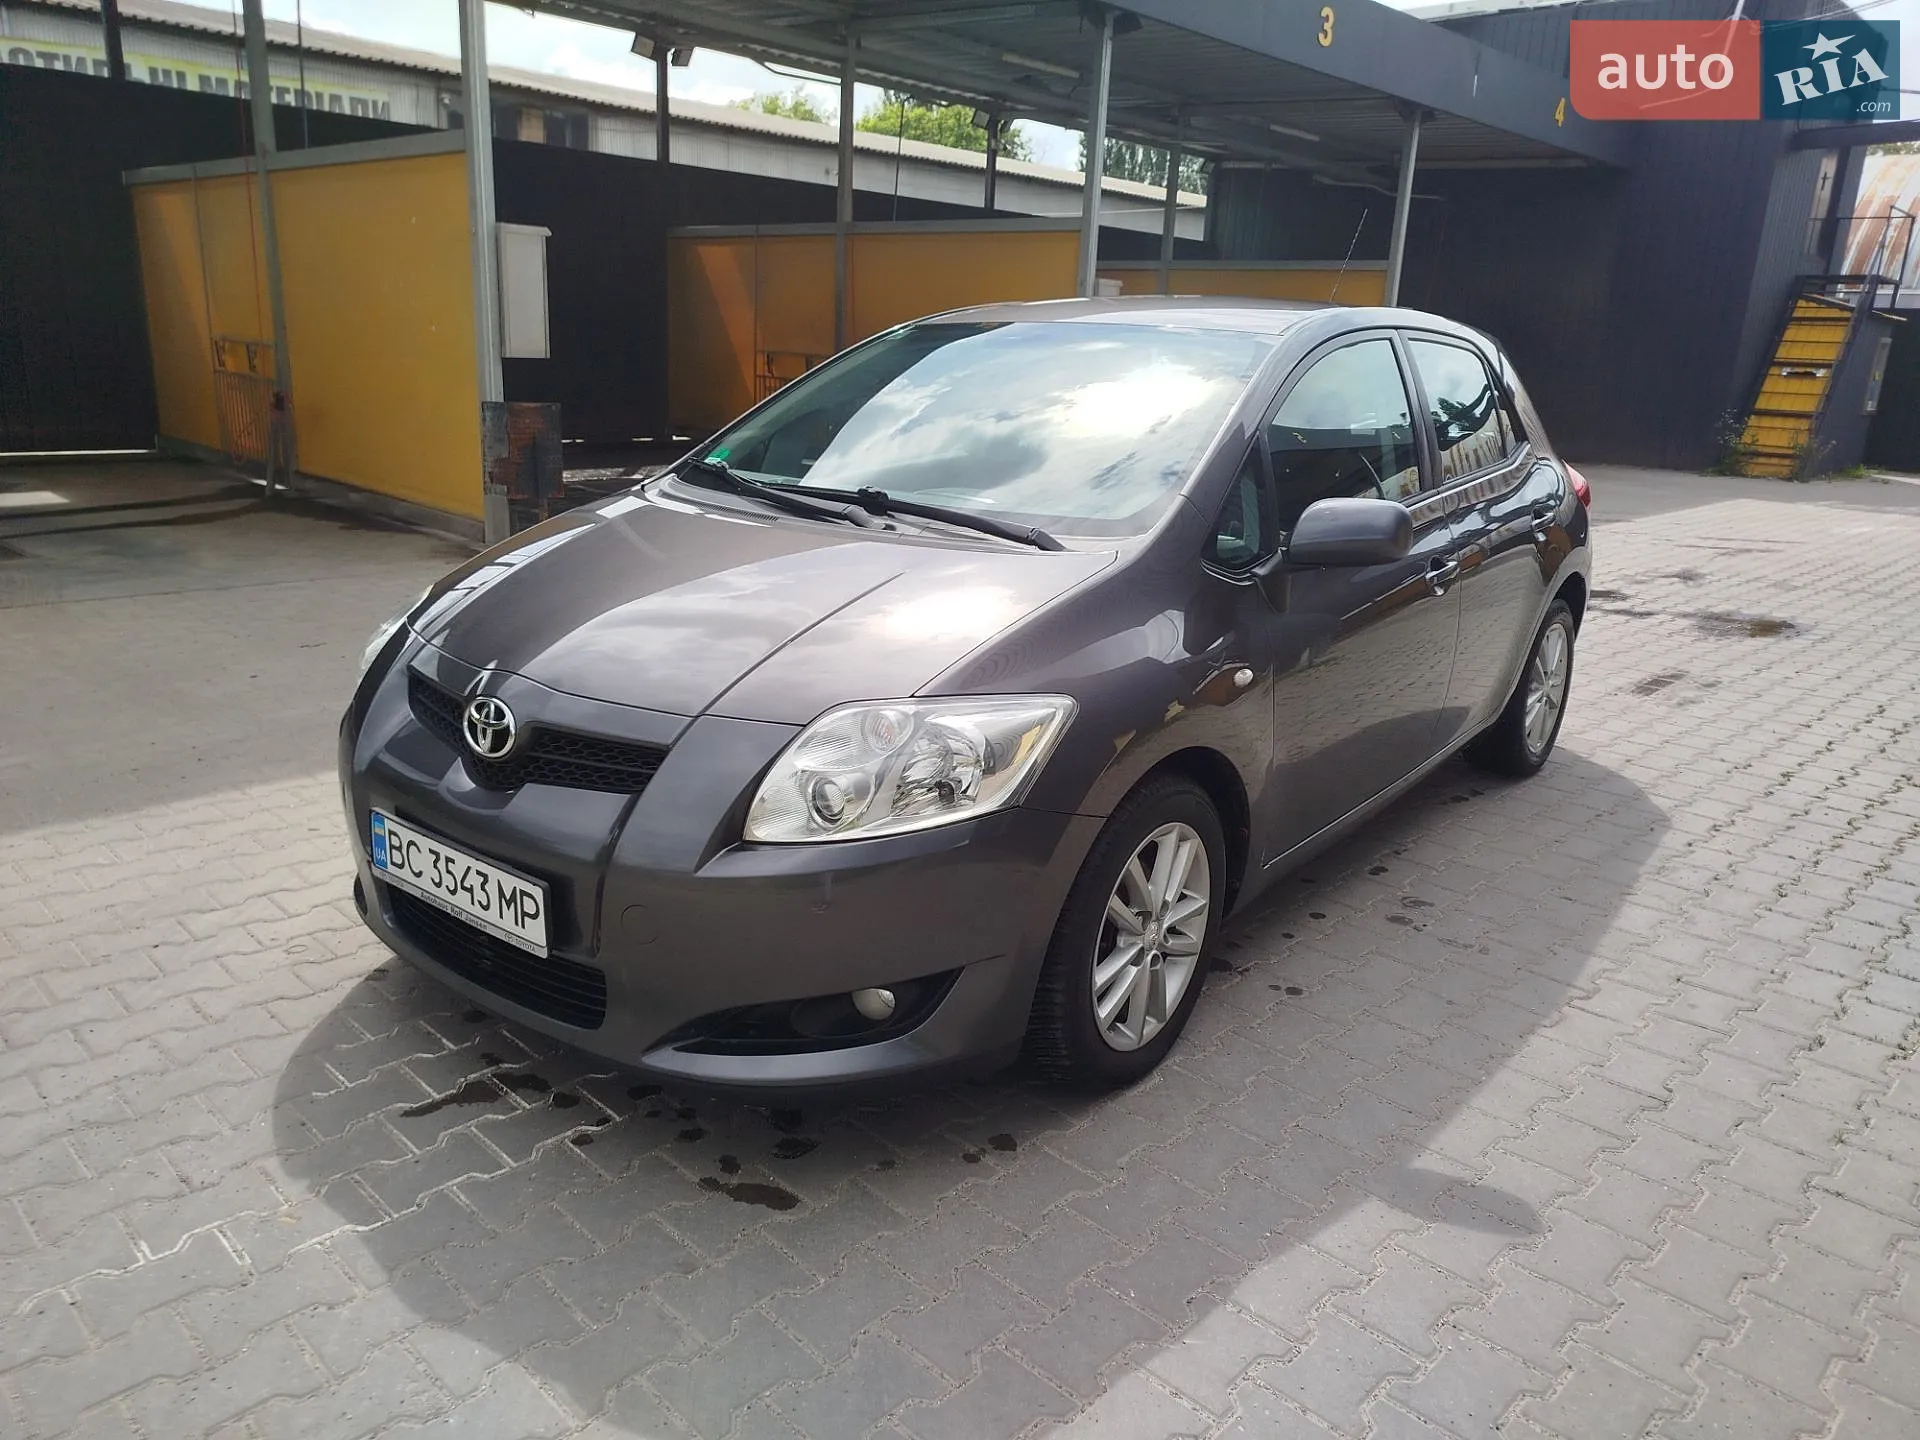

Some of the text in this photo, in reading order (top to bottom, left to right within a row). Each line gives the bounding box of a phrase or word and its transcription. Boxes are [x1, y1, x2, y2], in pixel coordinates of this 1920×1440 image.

[1318, 6, 1334, 47] 3
[198, 73, 391, 121] МАЕРІАЛИ
[1554, 97, 1565, 127] 4
[375, 847, 387, 862] UA
[388, 828, 540, 930] BC 3543 MP
